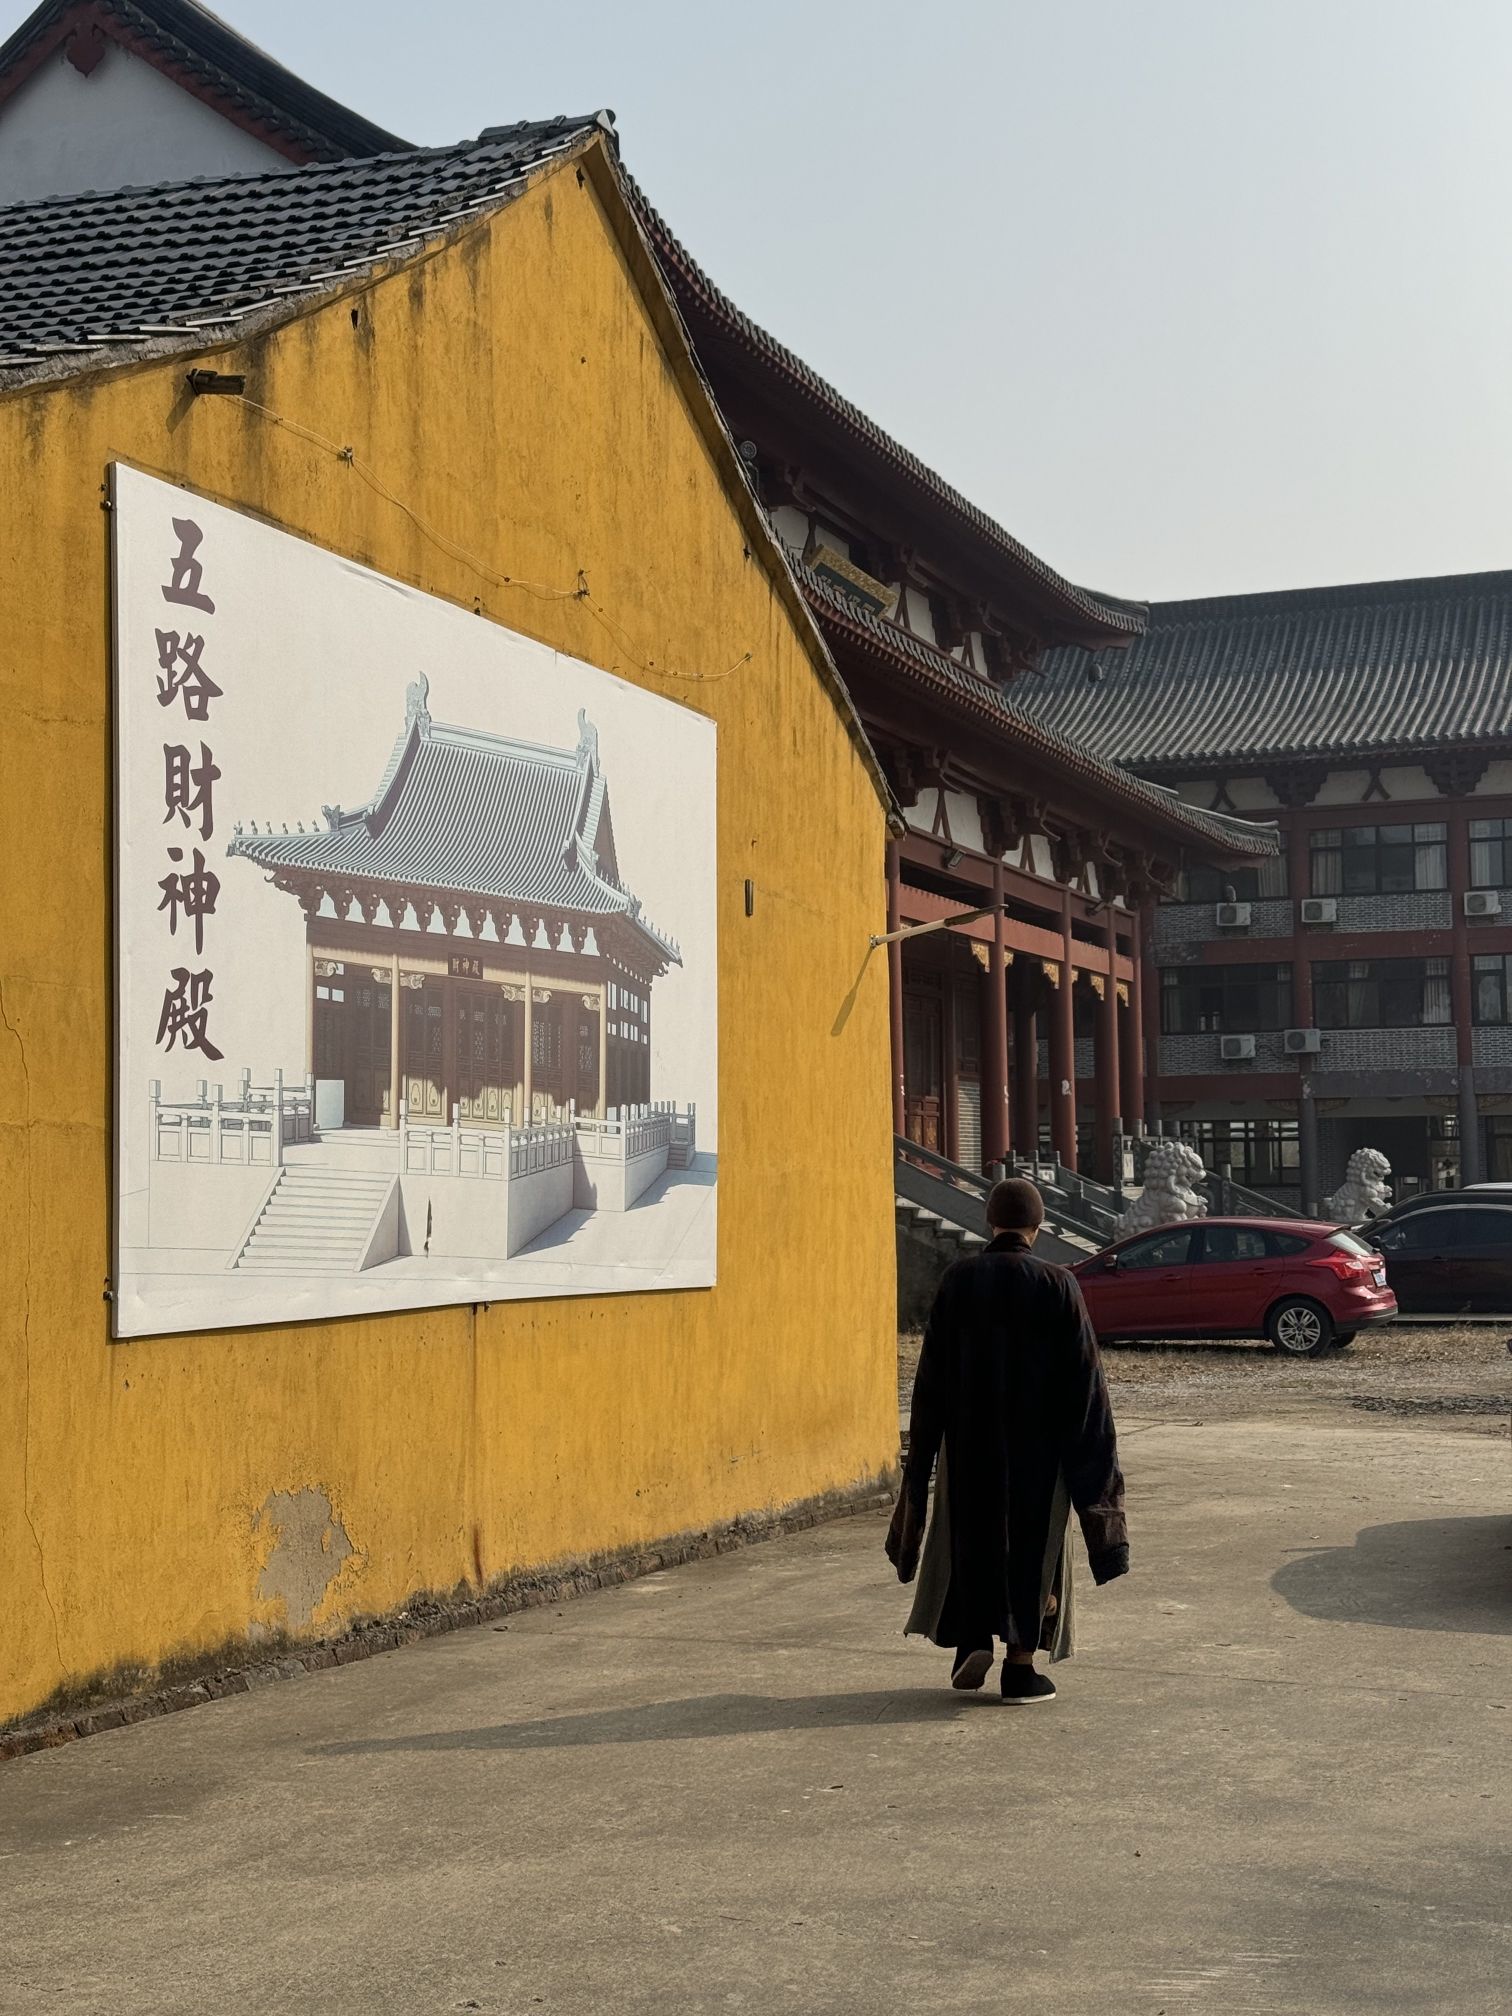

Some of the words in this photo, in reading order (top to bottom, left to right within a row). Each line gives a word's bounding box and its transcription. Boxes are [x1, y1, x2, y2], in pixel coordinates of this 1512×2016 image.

[155, 517, 225, 1060] 五路財神殿
